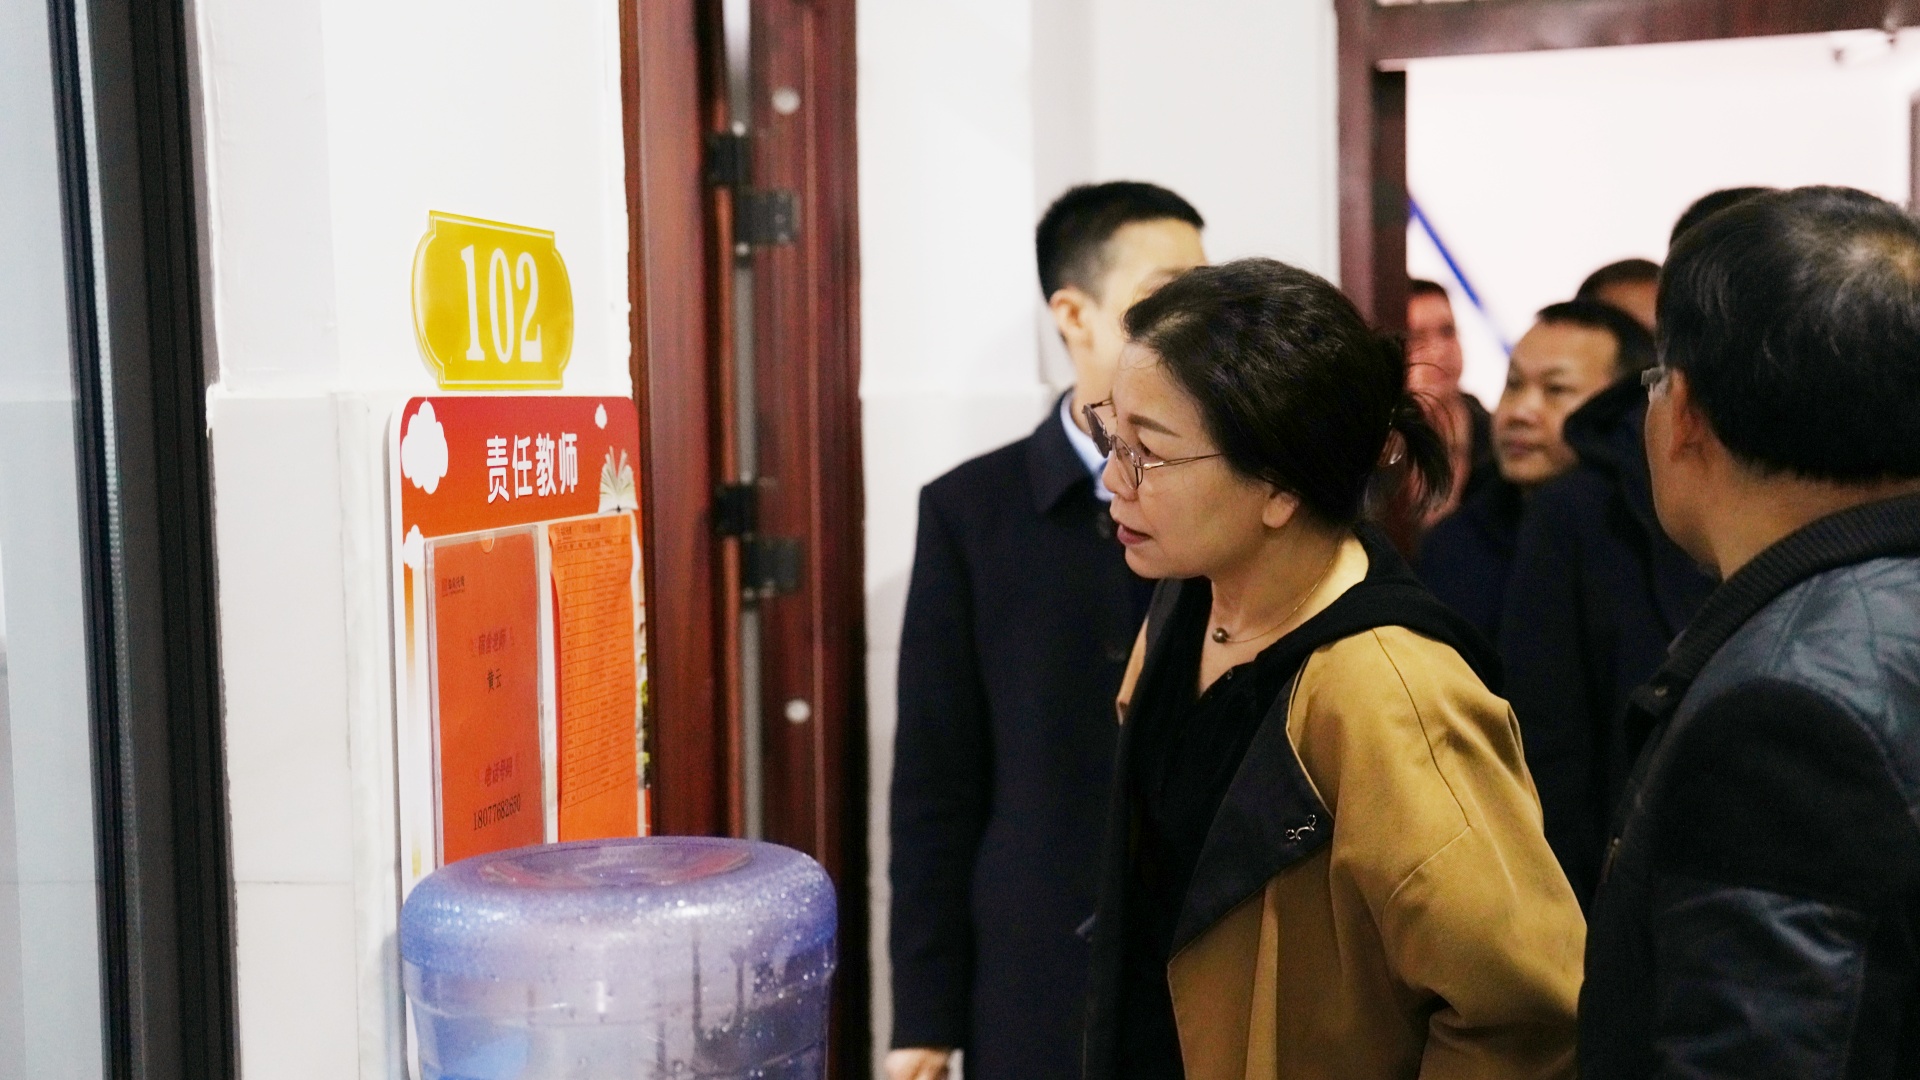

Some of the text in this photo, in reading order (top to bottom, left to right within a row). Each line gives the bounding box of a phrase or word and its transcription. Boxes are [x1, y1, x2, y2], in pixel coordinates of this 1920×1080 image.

[461, 244, 542, 363] 102
[486, 432, 578, 504] 责任教师
